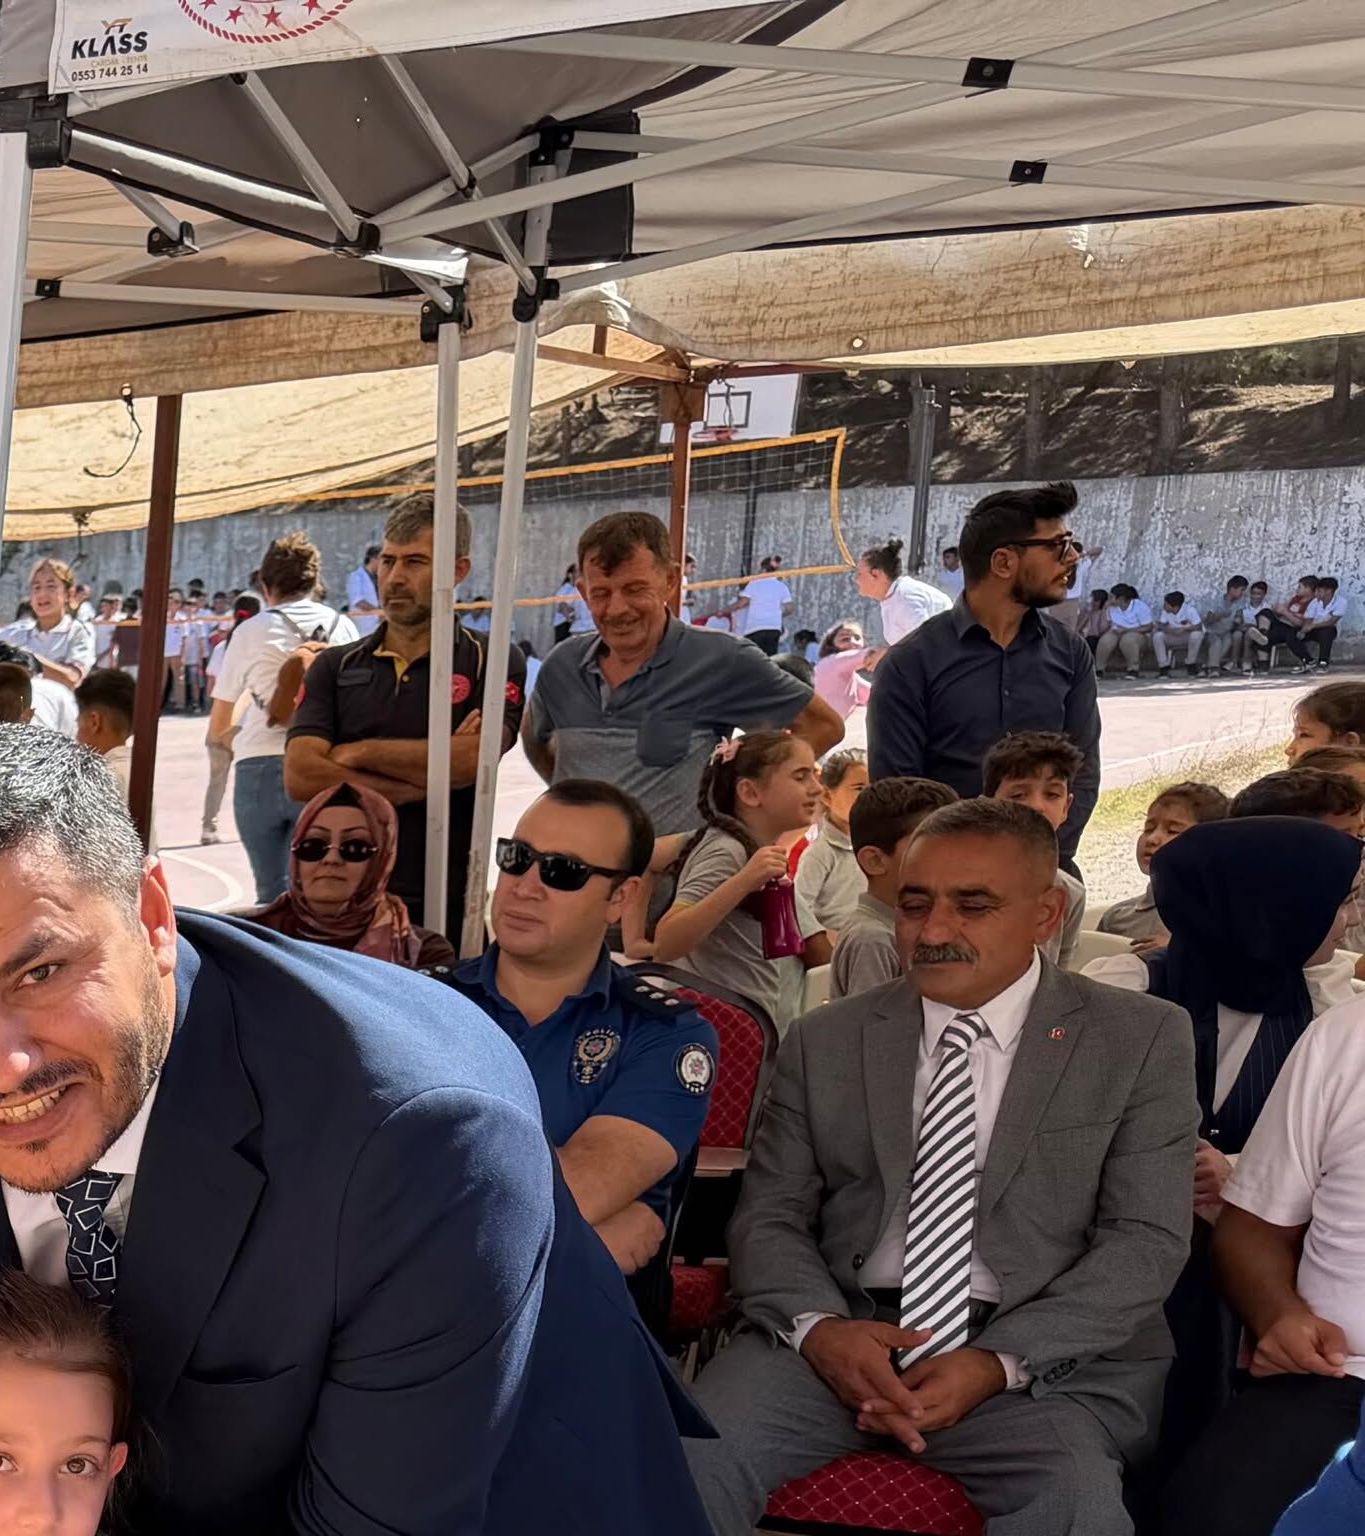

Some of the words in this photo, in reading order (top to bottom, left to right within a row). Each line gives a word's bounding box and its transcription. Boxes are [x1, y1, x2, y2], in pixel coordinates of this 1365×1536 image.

[71, 31, 148, 60] KLASS
[71, 69, 96, 82] 0553
[99, 67, 117, 79] 744
[120, 65, 133, 76] 25
[136, 63, 148, 74] 14
